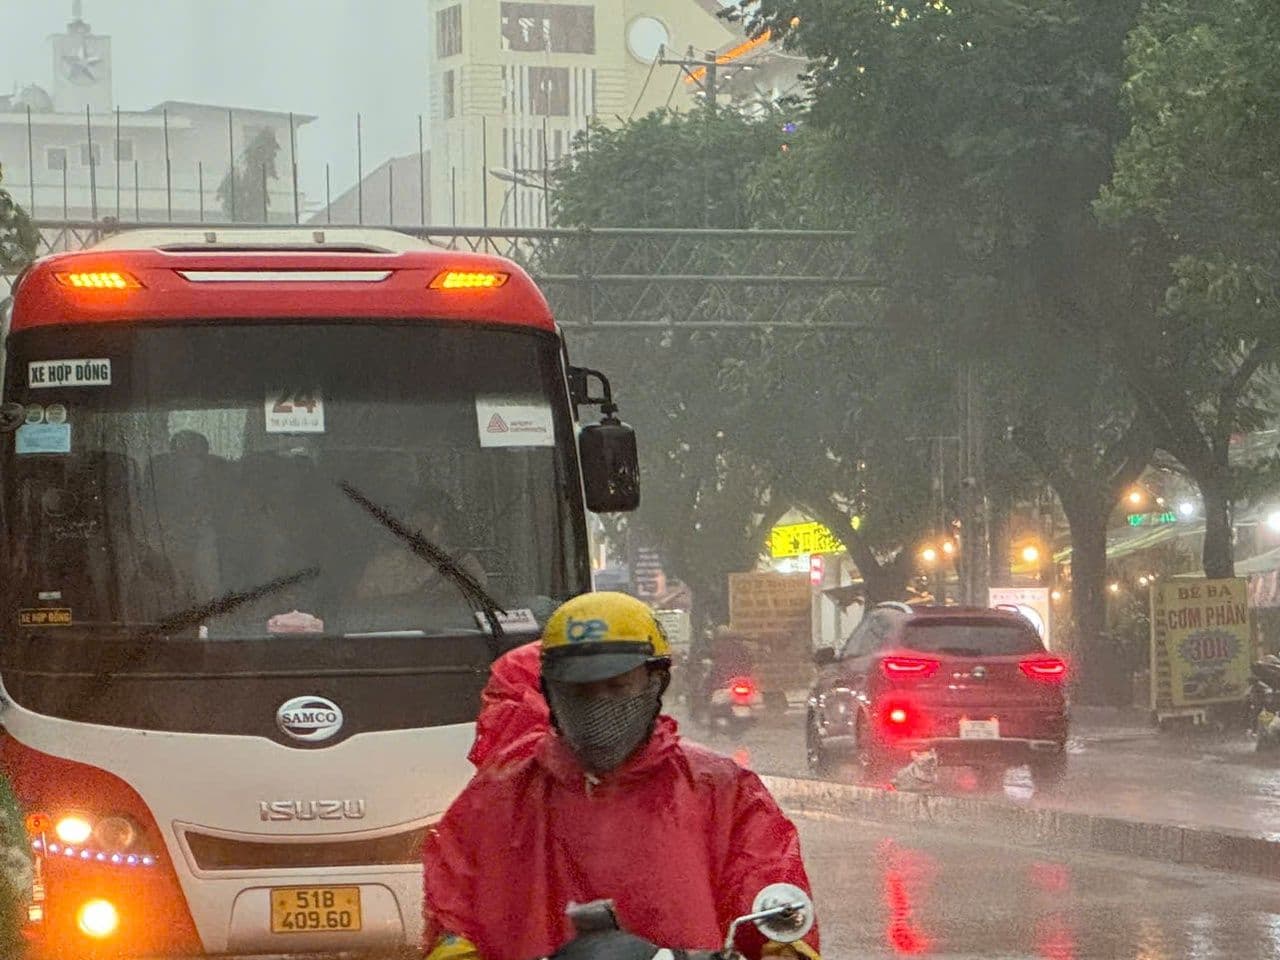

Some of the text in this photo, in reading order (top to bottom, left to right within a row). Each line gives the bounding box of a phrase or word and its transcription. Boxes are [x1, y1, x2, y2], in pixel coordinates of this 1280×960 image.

[31, 367, 45, 383] XE
[48, 363, 72, 384] HỢP
[567, 616, 608, 642] be
[282, 712, 337, 723] SAMCO
[260, 799, 366, 820] ISUZU
[296, 891, 335, 908] 51B
[282, 911, 351, 929] 409.60
